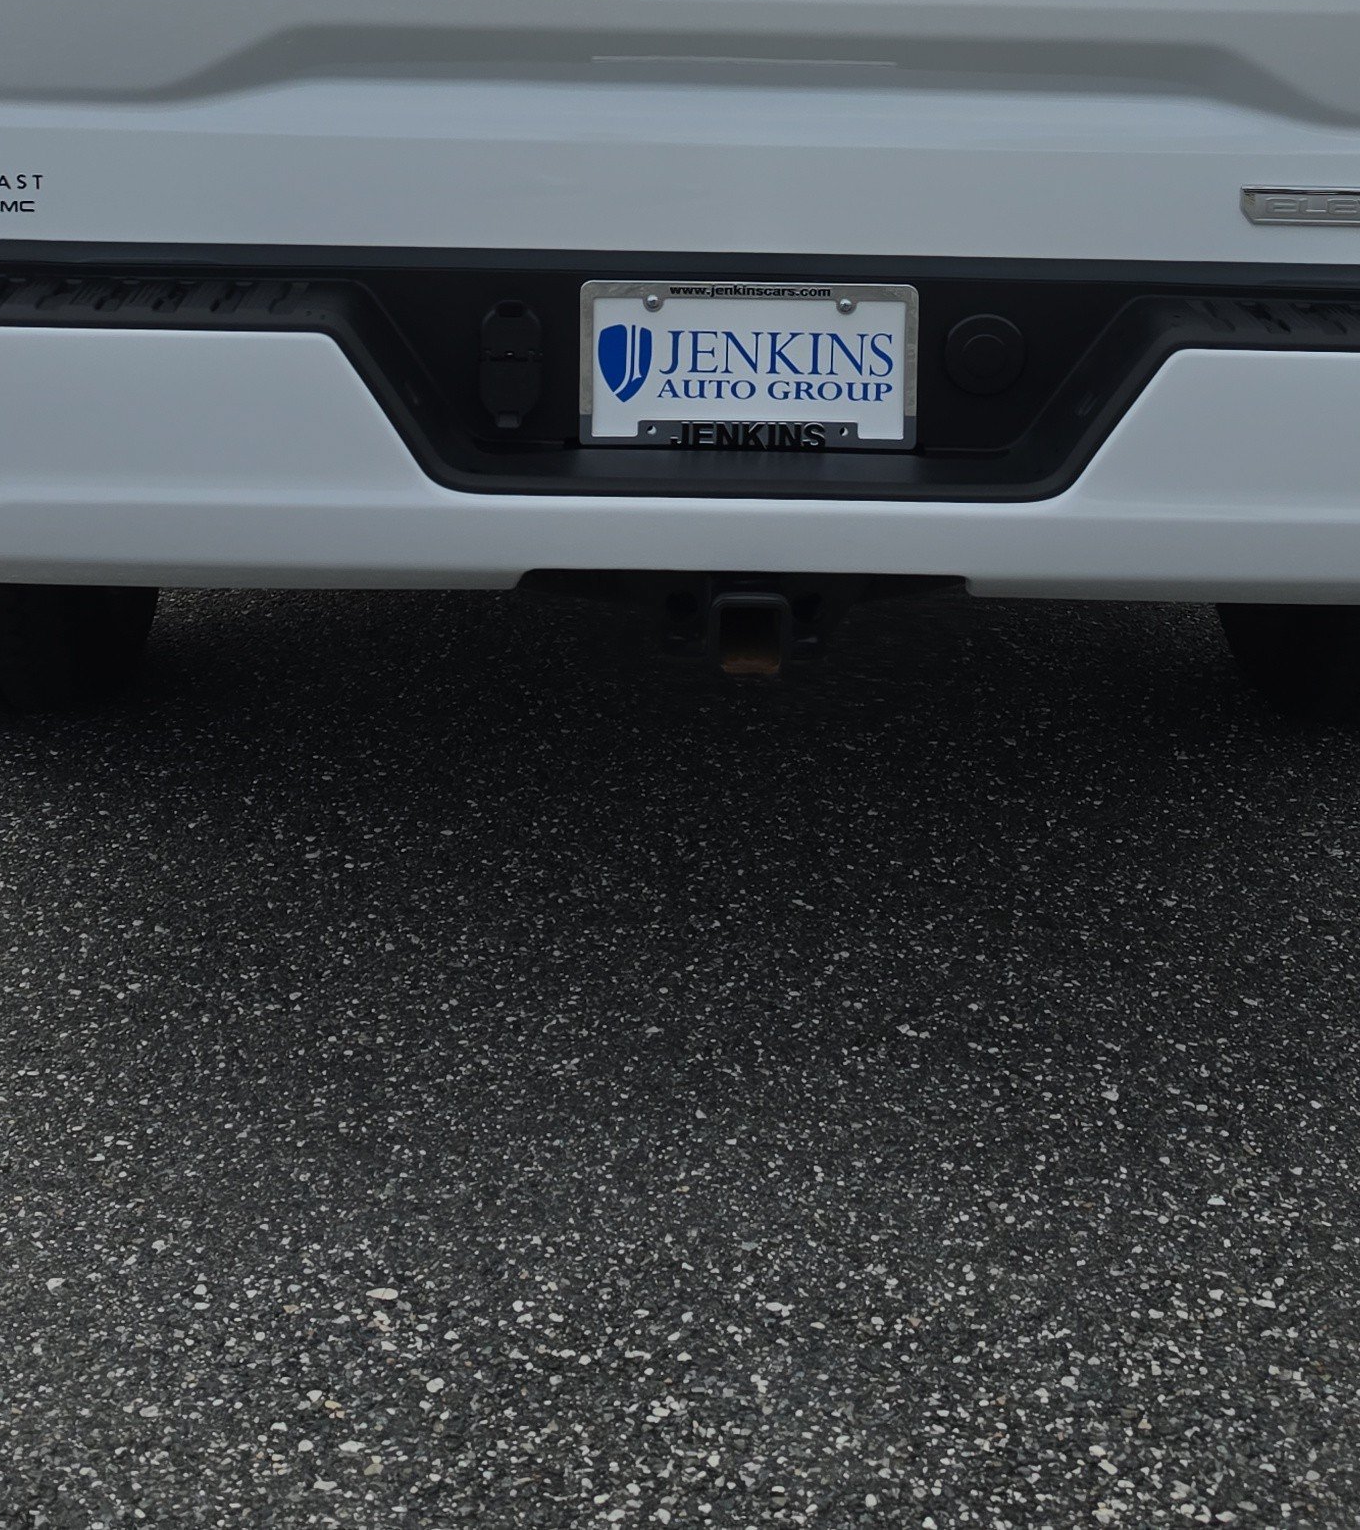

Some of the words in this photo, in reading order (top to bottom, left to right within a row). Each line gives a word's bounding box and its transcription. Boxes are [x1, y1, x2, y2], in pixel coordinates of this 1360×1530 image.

[669, 284, 832, 298] www.jenkinscars.com
[658, 330, 894, 377] JENKINS
[657, 379, 757, 400] AUTO
[767, 379, 894, 402] GROUP
[669, 420, 828, 450] JENKINS
